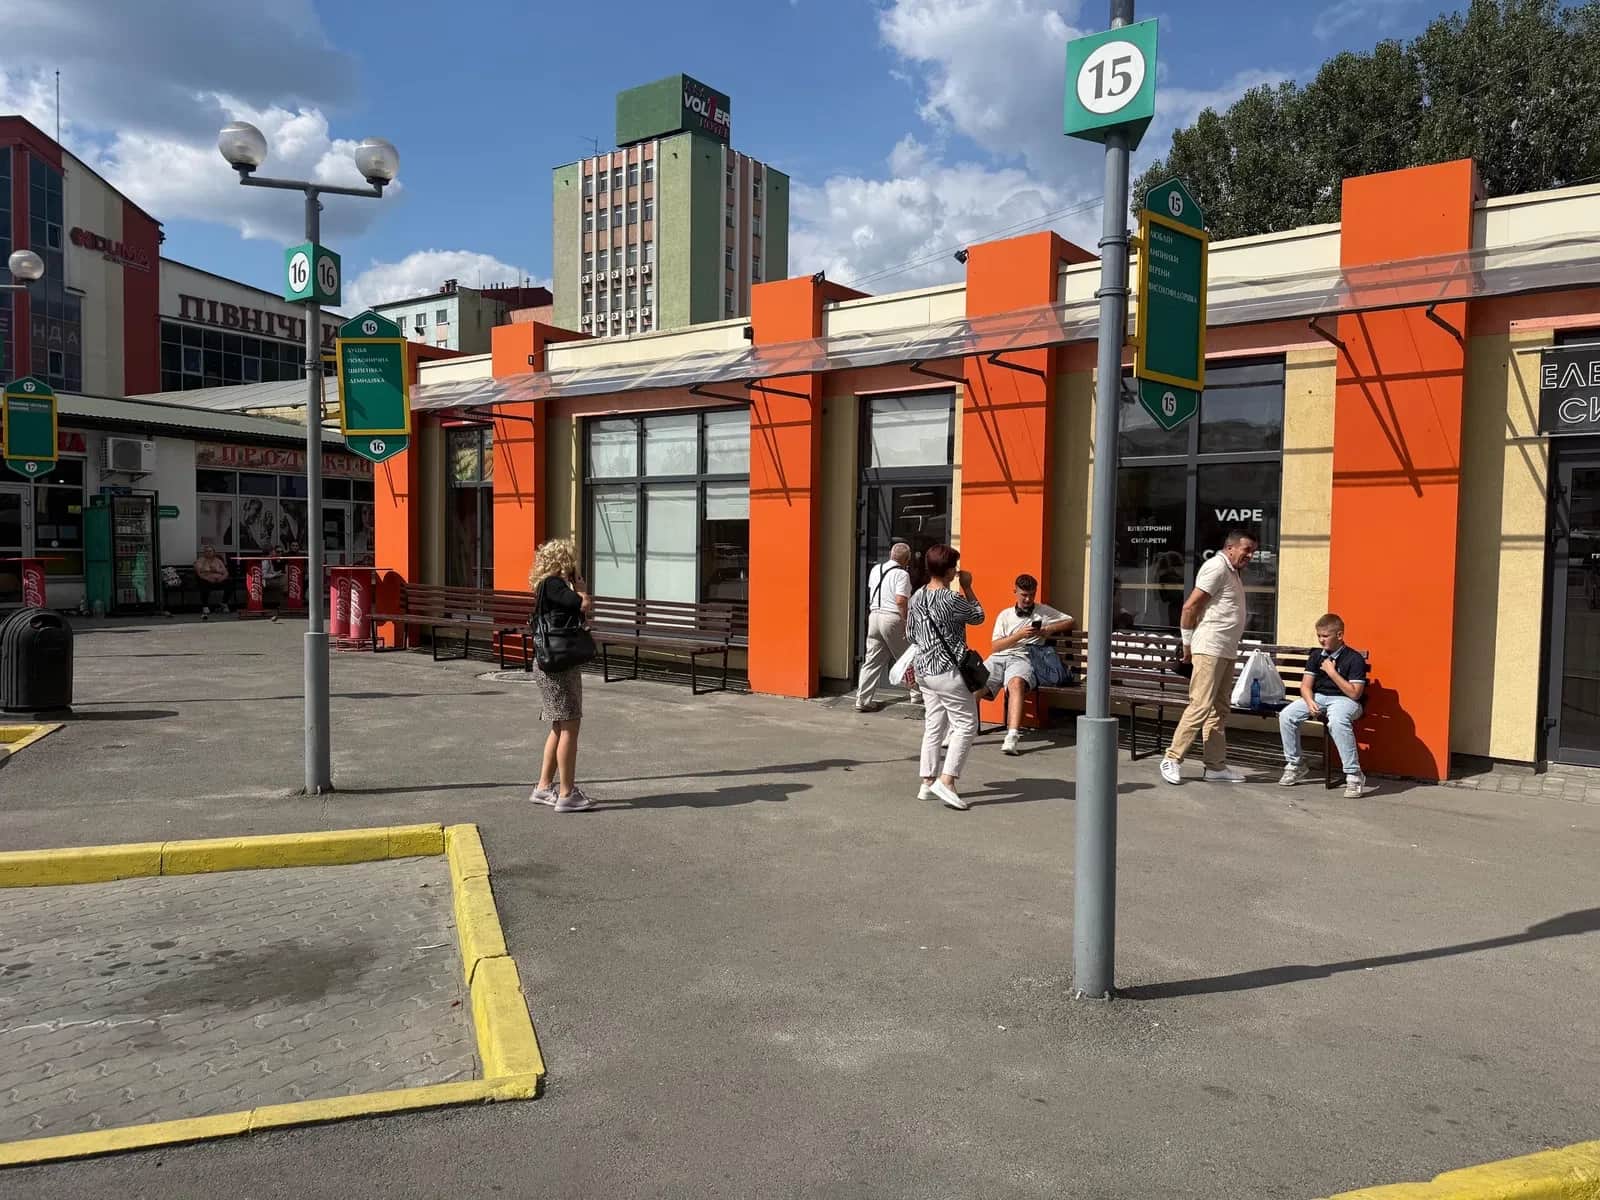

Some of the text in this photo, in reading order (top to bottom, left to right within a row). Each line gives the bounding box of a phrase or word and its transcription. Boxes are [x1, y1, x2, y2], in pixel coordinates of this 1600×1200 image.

[1087, 55, 1132, 99] 15
[1170, 194, 1181, 212] 15
[291, 260, 306, 284] 16
[319, 263, 335, 289] 16
[365, 322, 376, 333] 16
[25, 383, 34, 392] 17
[1164, 397, 1174, 412] 15
[373, 442, 384, 452] 16
[221, 446, 372, 474] ПРОДКТИ
[27, 463, 36, 472] 17
[1214, 509, 1263, 522] VAPE
[1131, 537, 1167, 545] СИГАРЕТИ
